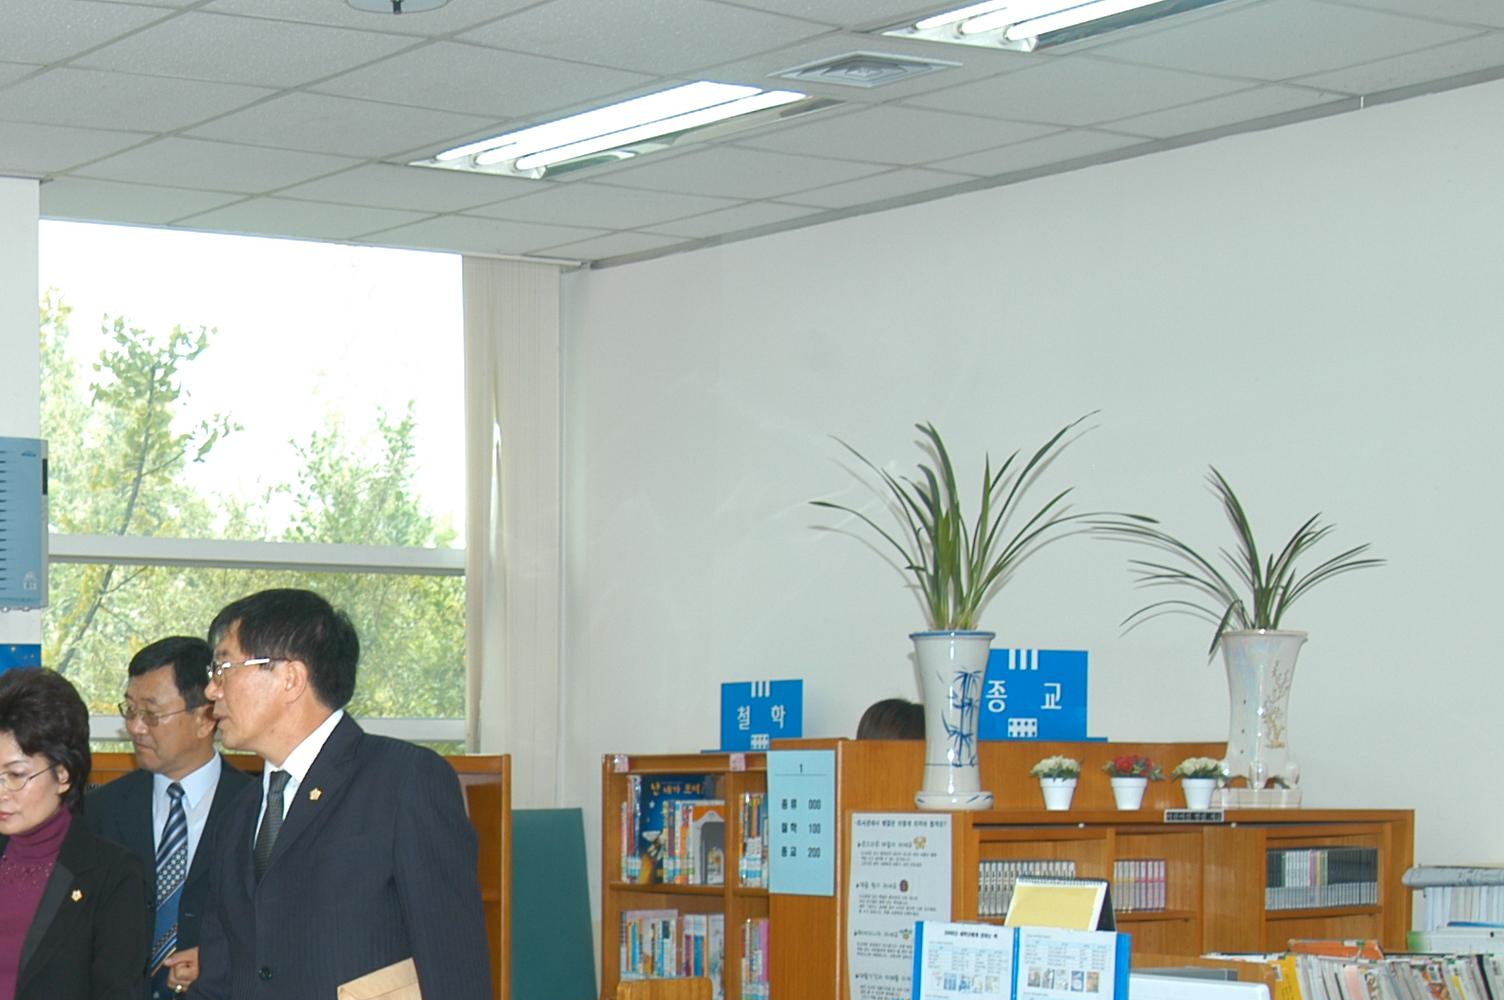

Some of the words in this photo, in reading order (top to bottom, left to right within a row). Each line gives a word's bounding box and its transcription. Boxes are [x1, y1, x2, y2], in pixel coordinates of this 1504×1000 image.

[985, 680, 1063, 713] 종교
[736, 705, 786, 730] 철학
[808, 799, 821, 810] 000
[808, 823, 821, 834] 100
[808, 847, 821, 858] 200
